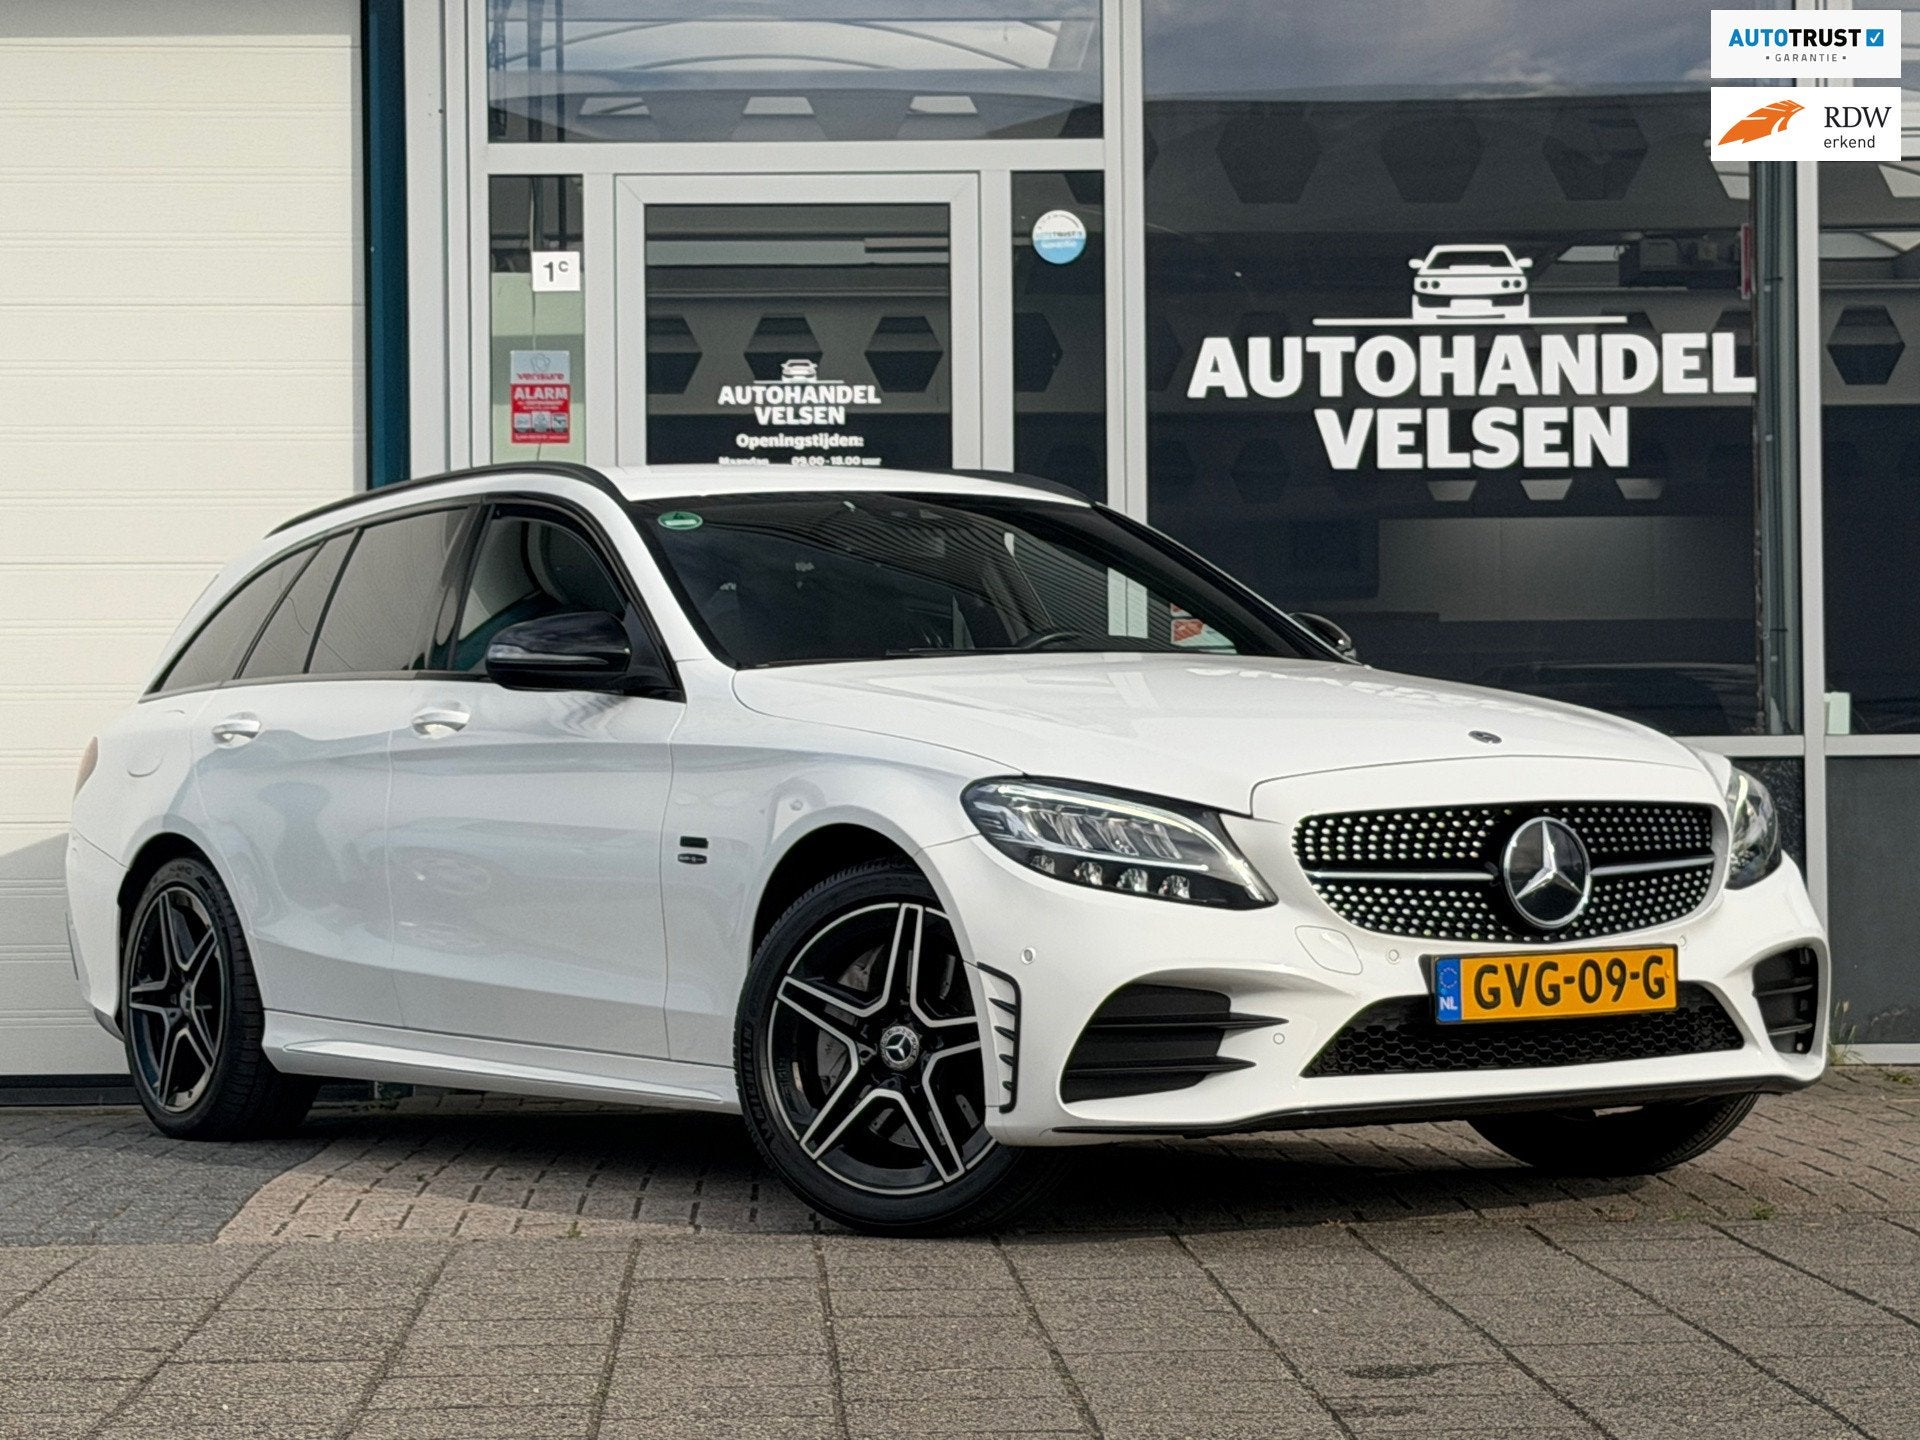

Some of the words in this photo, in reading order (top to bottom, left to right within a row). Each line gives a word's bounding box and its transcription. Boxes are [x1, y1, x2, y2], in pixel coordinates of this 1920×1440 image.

[1187, 332, 1757, 399] AUTOHANDEL
[514, 386, 568, 400] ALARM
[718, 385, 882, 406] AUTOHANDEL
[753, 406, 846, 426] VELSEN
[735, 432, 864, 451] Openingstijden:
[1314, 405, 1629, 470] VELSEN
[1473, 954, 1666, 1011] GVG-09-G
[1439, 996, 1458, 1011] NL
